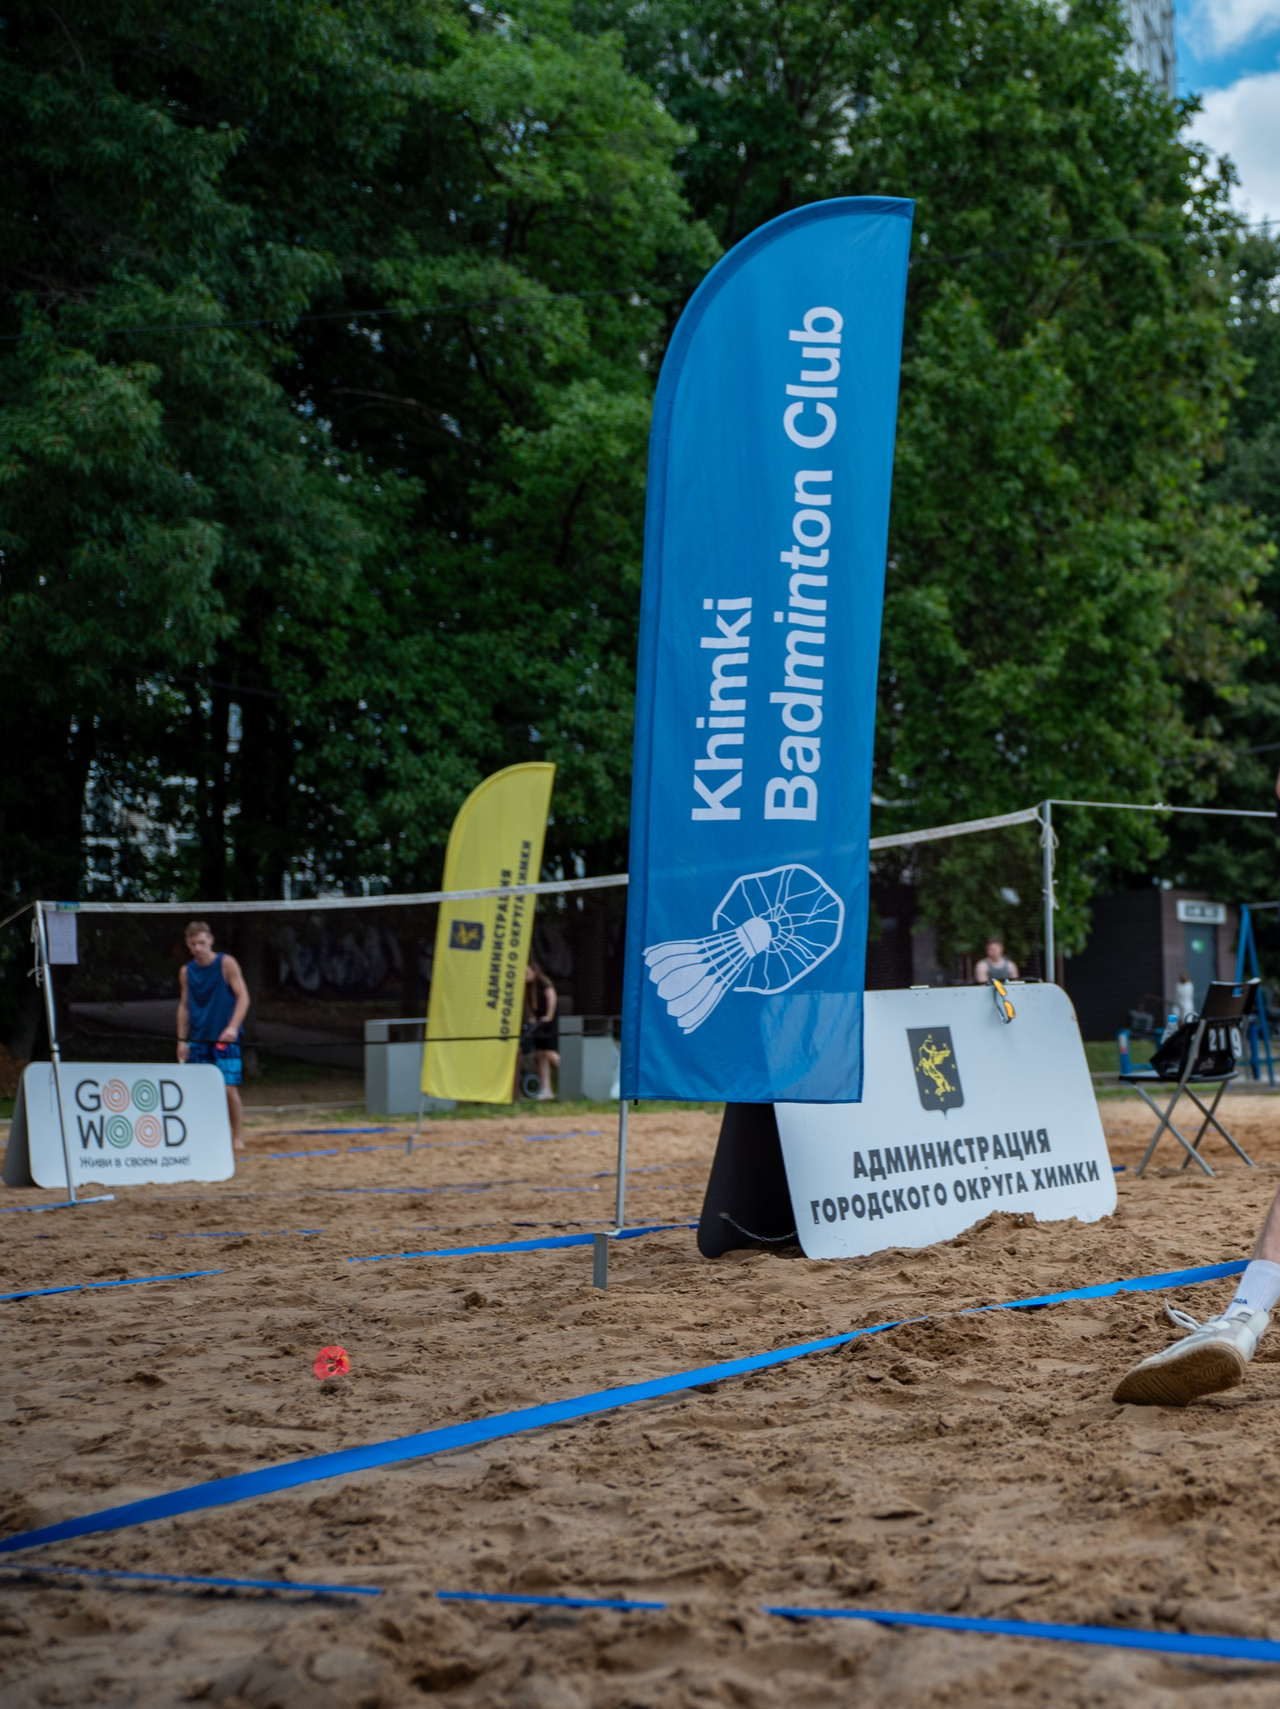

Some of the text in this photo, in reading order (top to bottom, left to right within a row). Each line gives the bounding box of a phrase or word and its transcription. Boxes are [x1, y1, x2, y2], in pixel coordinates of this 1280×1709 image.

[764, 306, 844, 822] Badminton Club
[691, 597, 752, 821] Khimki
[75, 1079, 183, 1113] GOOD
[77, 1114, 187, 1149] WOOD
[853, 1127, 1051, 1182] АДМИНИСТРАЦИЯ
[80, 1156, 112, 1169] Живи
[115, 1158, 122, 1166] в
[810, 1160, 1100, 1225] ГОРОДСКОГО ОКРУГА ХИМКИ
